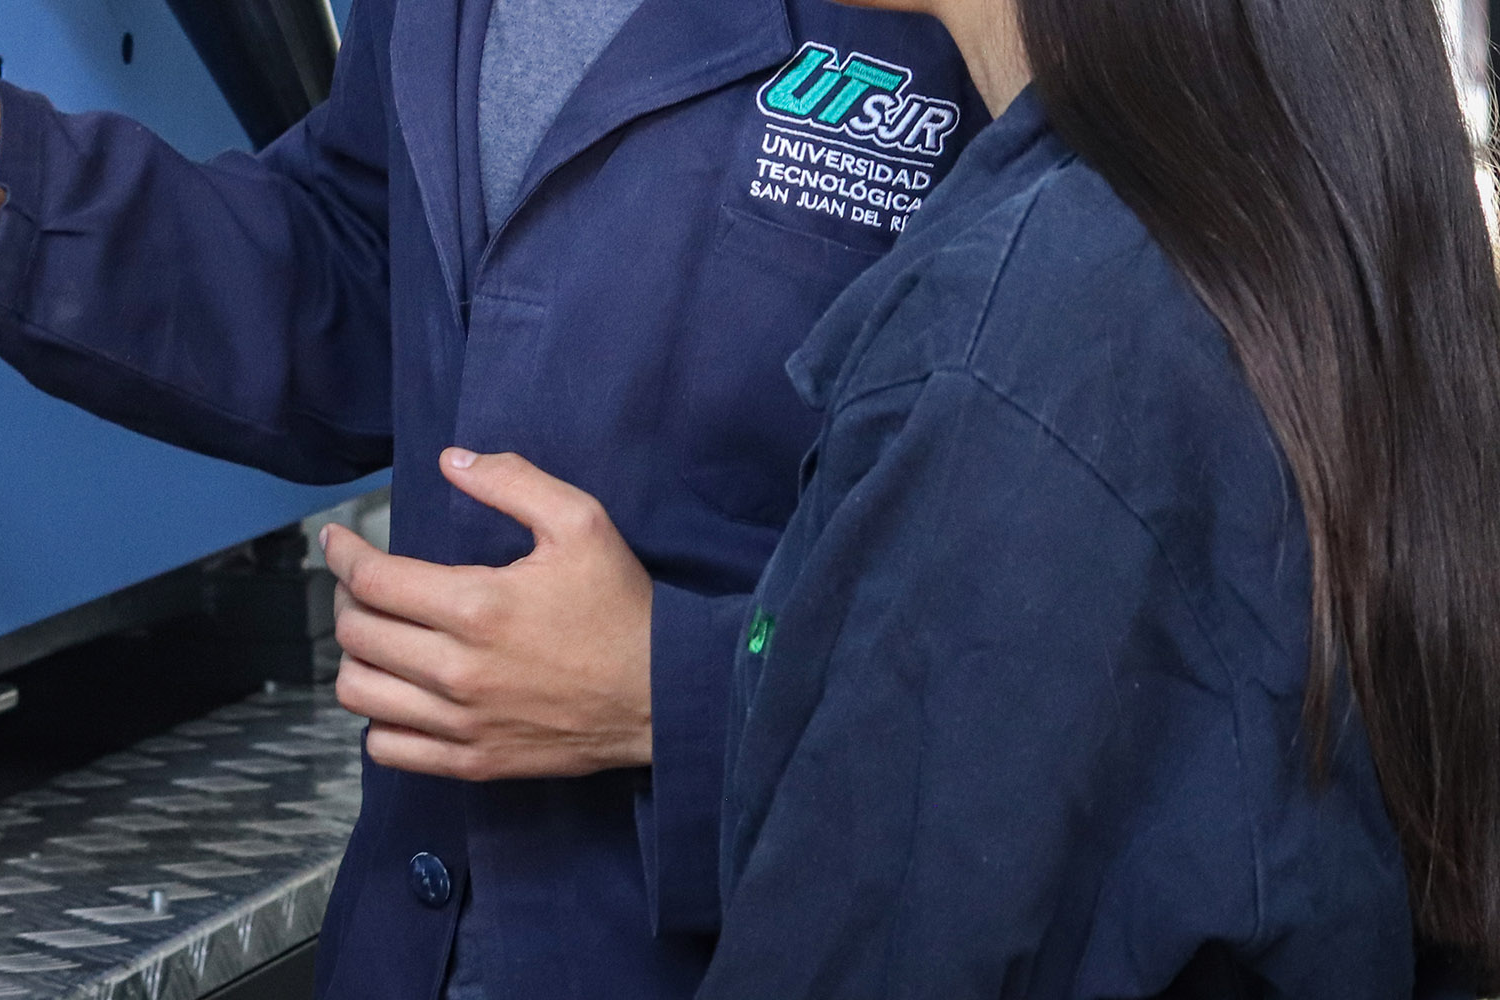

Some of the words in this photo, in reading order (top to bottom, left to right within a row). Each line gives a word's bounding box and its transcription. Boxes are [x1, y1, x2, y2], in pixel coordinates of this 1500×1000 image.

[756, 158, 923, 212] TECNOLÓGICA
[761, 133, 932, 191] UNIVERSIDAD
[750, 180, 790, 204] SAN
[796, 191, 847, 218] JUAN
[850, 206, 883, 228] DEL
[889, 213, 910, 233] RÍ
